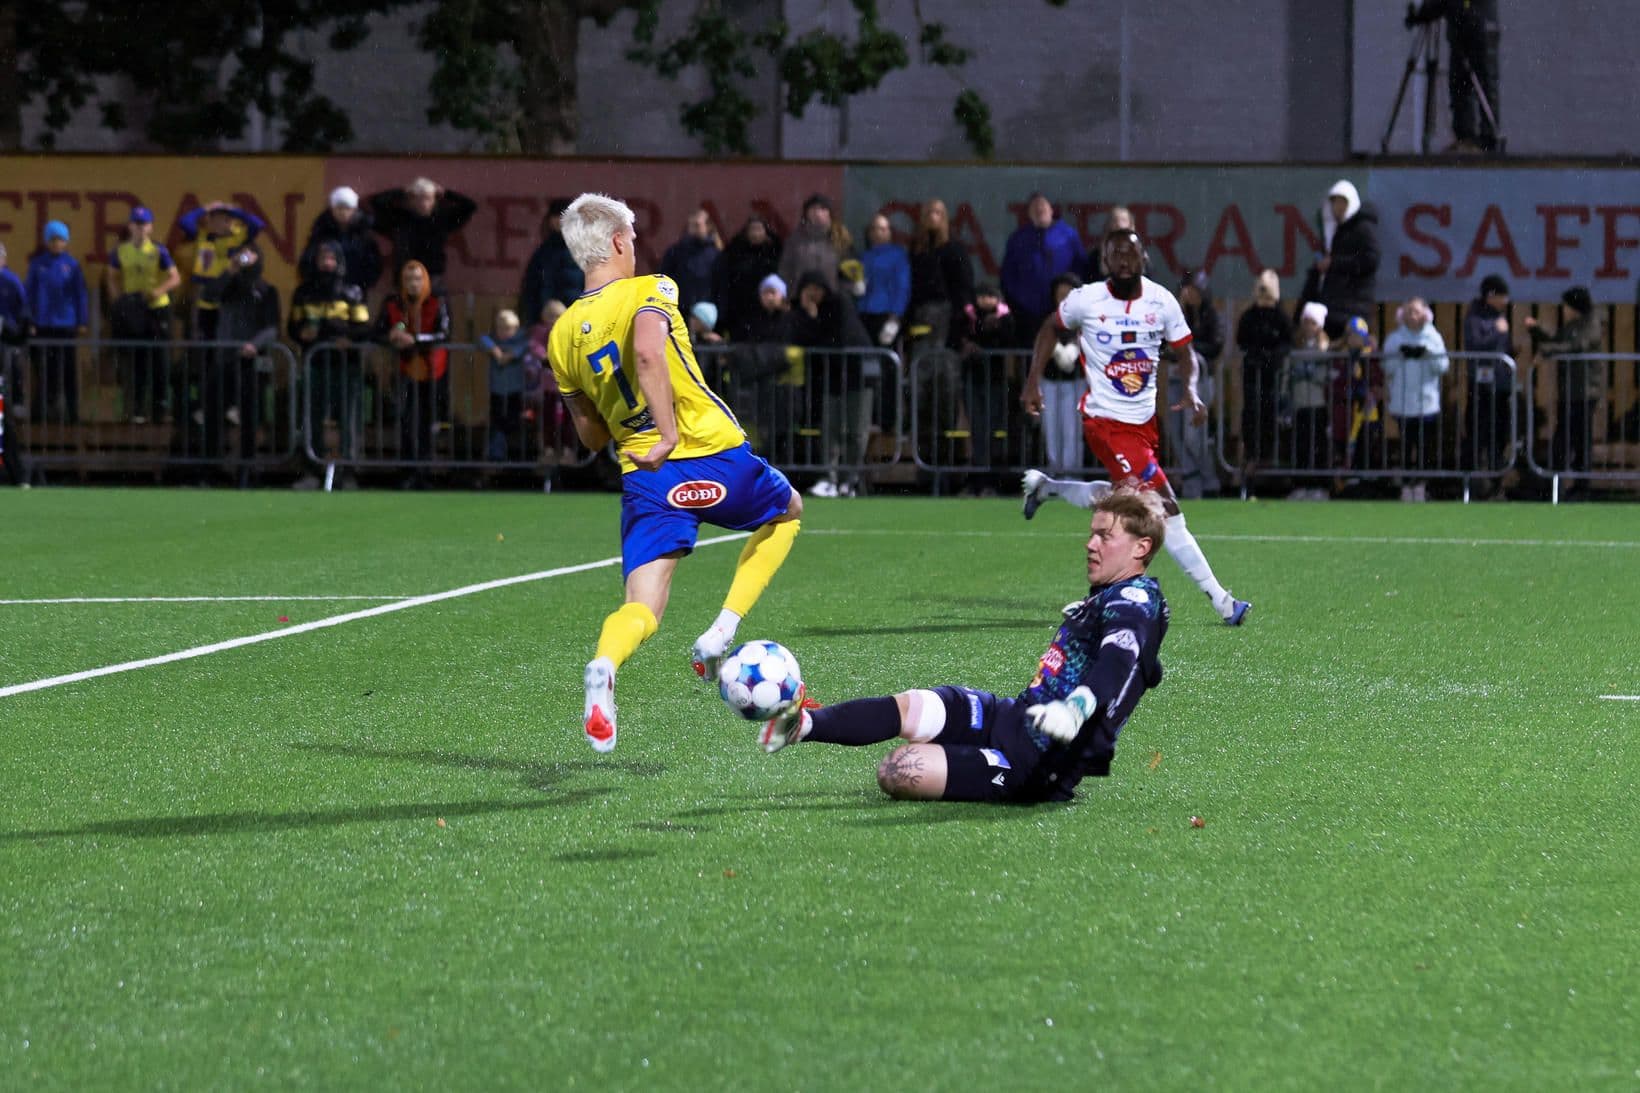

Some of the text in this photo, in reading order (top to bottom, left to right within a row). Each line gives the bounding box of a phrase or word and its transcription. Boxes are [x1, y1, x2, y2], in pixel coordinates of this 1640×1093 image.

[1399, 203, 1640, 279] SAFF
[587, 340, 637, 411] 7
[1115, 453, 1132, 473] 5
